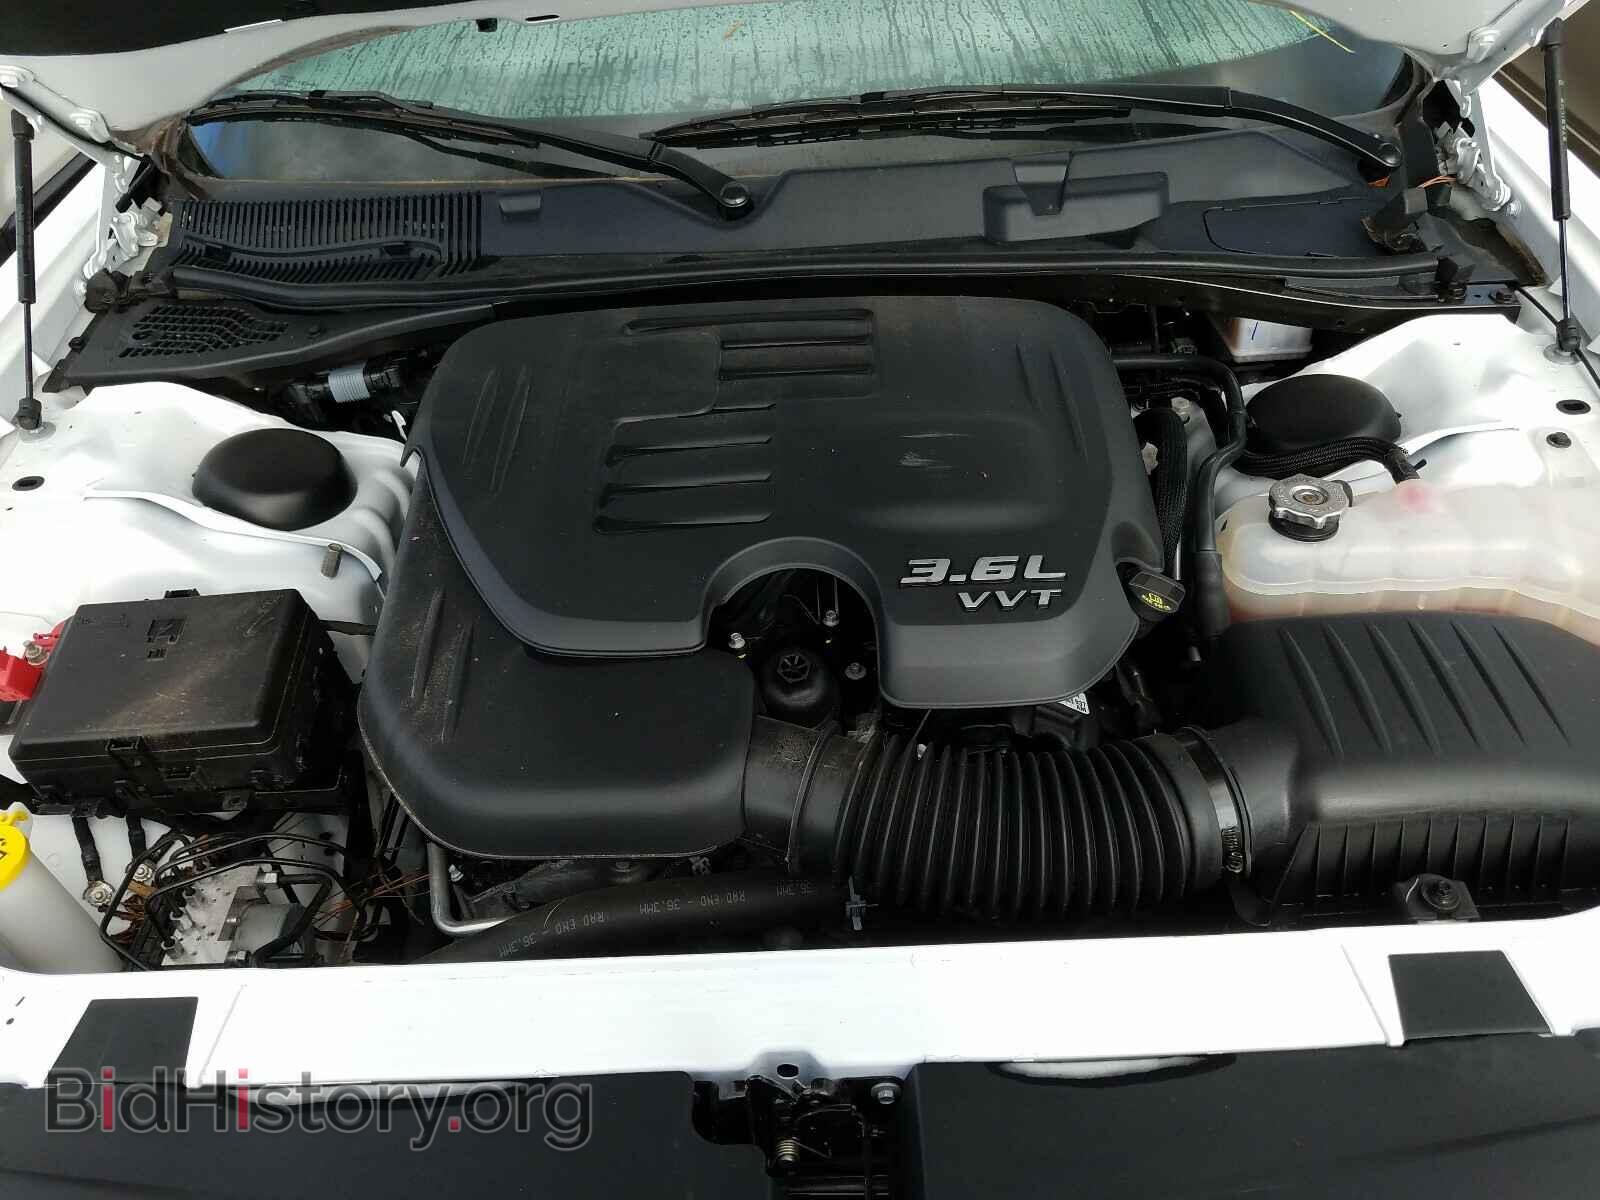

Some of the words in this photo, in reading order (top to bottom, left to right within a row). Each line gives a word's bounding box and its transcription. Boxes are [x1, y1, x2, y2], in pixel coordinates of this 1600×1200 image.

[900, 555, 1067, 586] 3.6L
[957, 589, 1062, 612] VVT
[700, 893, 720, 906] END
[726, 889, 746, 904] RAD
[555, 918, 577, 934] END
[583, 911, 606, 927] RAD
